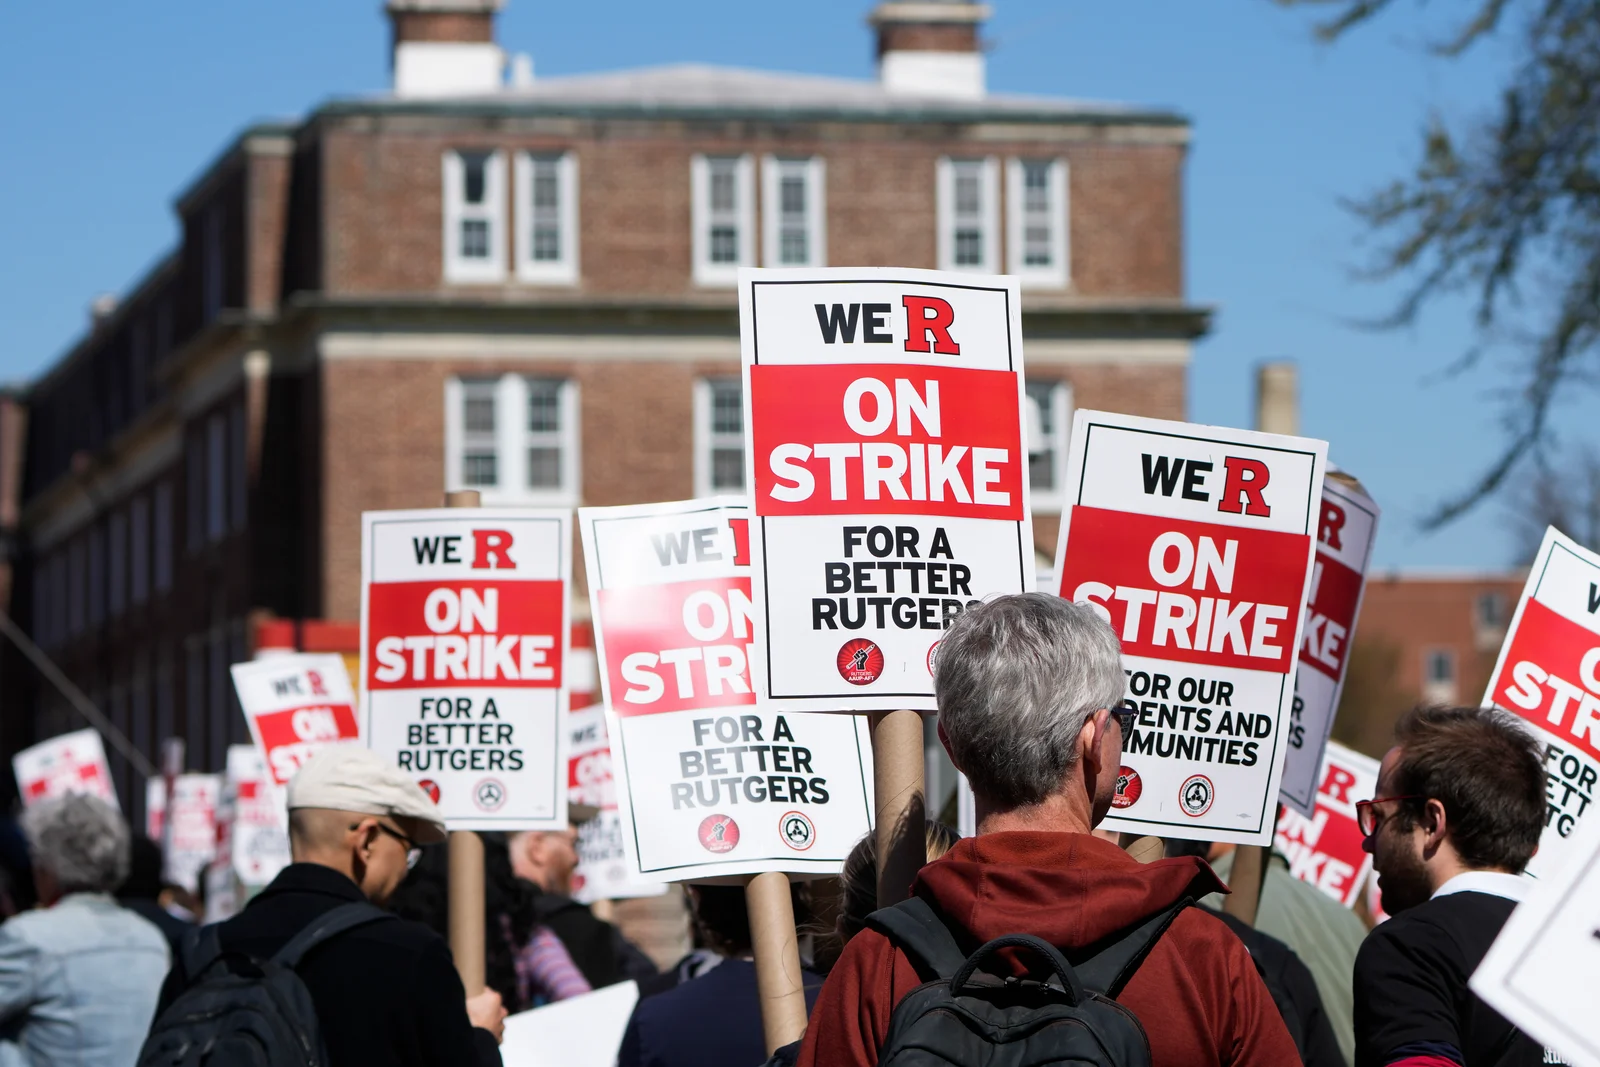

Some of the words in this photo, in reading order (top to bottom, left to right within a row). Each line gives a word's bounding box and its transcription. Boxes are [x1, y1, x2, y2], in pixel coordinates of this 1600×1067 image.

[815, 303, 893, 344] WE
[902, 294, 960, 355] R
[843, 376, 941, 437] ON
[769, 442, 1011, 506] STRIKE
[1141, 453, 1213, 502] WE
[1218, 456, 1270, 518] R
[413, 536, 462, 565] WE
[471, 529, 517, 570] R
[652, 526, 723, 567] WE
[842, 525, 920, 558] FOR
[928, 527, 954, 559] A
[1148, 531, 1239, 594] ON
[825, 561, 972, 596] BETTER
[424, 587, 499, 634] ON
[812, 597, 984, 630] RUTGER
[1073, 581, 1289, 660] STRIKE
[374, 634, 554, 682] STRIKE
[620, 644, 755, 705] STR
[420, 698, 472, 719] FOR
[482, 697, 500, 719] A
[1124, 669, 1171, 700] OR
[1178, 677, 1234, 706] OUR
[1504, 660, 1600, 752] STR
[408, 723, 514, 745] BETTER
[692, 715, 764, 746] FOR
[772, 715, 795, 743] A
[1215, 710, 1272, 738] AND
[398, 750, 524, 772] RUTGERS
[679, 745, 814, 779] BETTER
[1122, 729, 1259, 767] MUNITIES
[1542, 743, 1597, 794] FOR
[670, 775, 830, 810] RUTGERS
[1318, 763, 1357, 806] R
